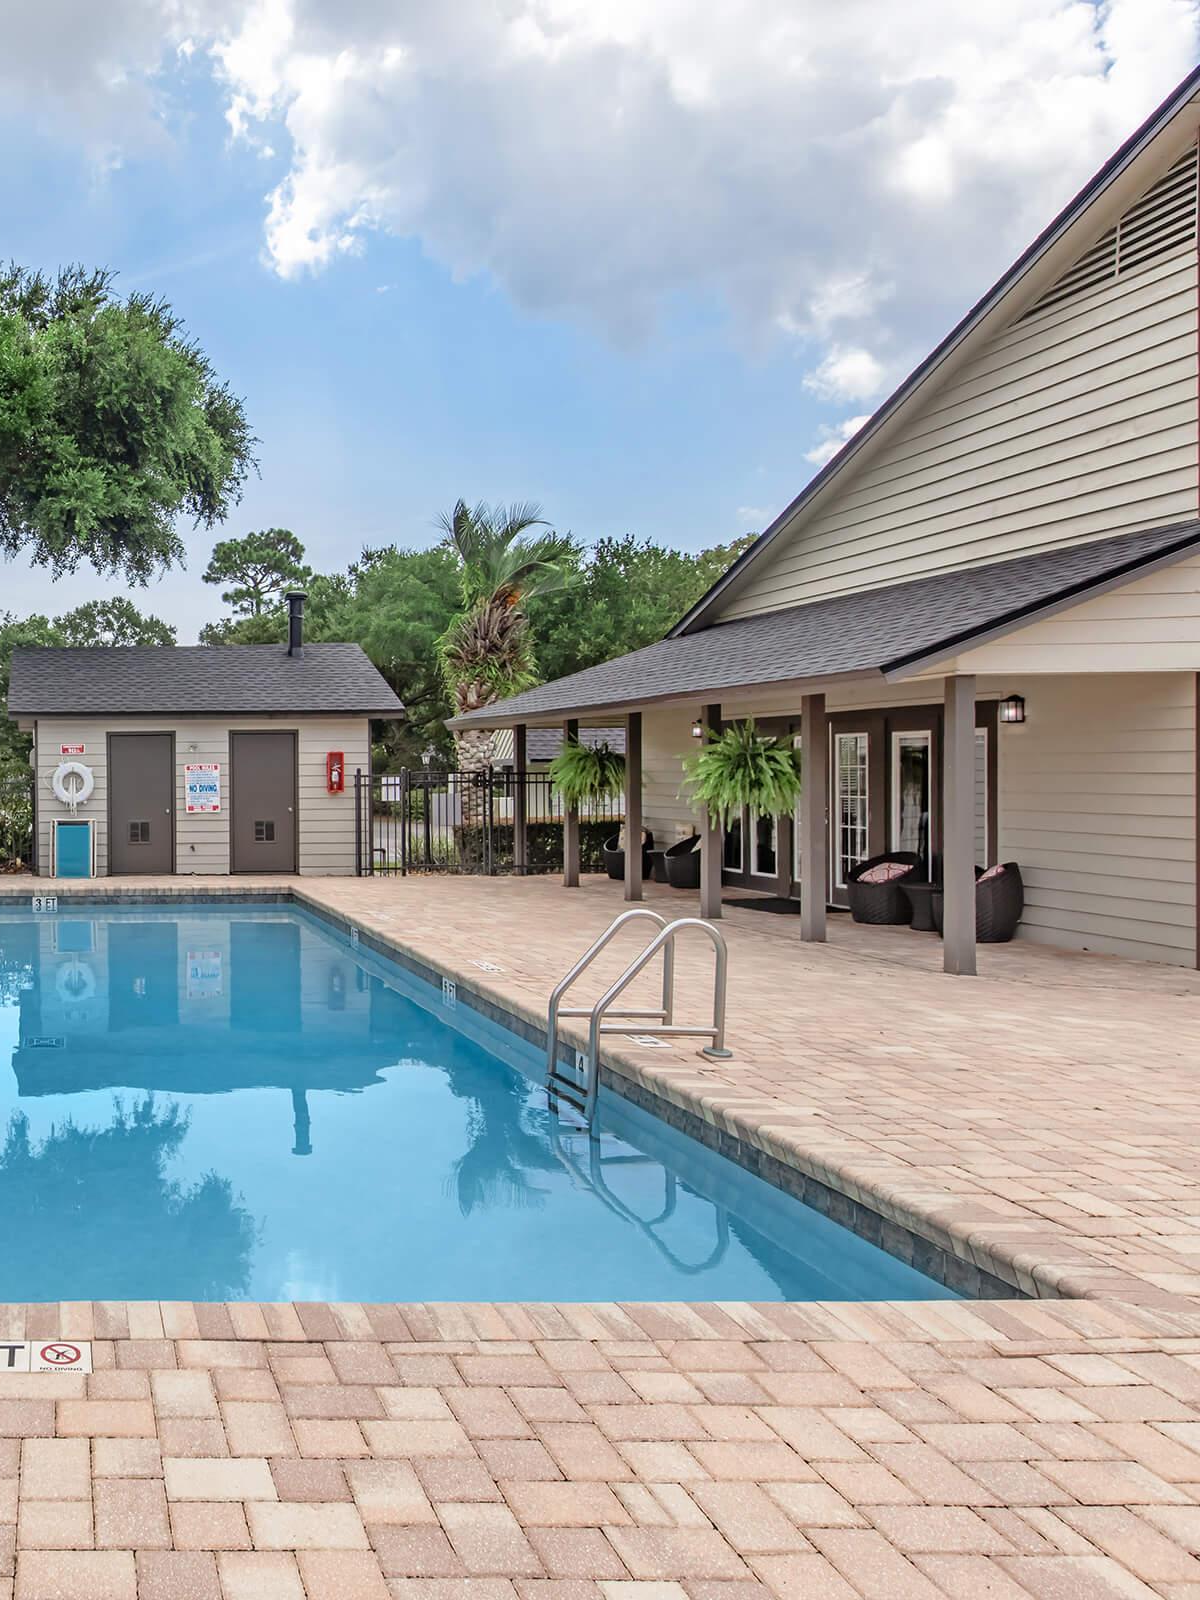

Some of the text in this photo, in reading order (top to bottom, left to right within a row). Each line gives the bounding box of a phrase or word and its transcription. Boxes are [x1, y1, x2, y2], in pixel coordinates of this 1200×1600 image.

[189, 784, 217, 792] NO DIVING
[579, 1055, 584, 1072] 4
